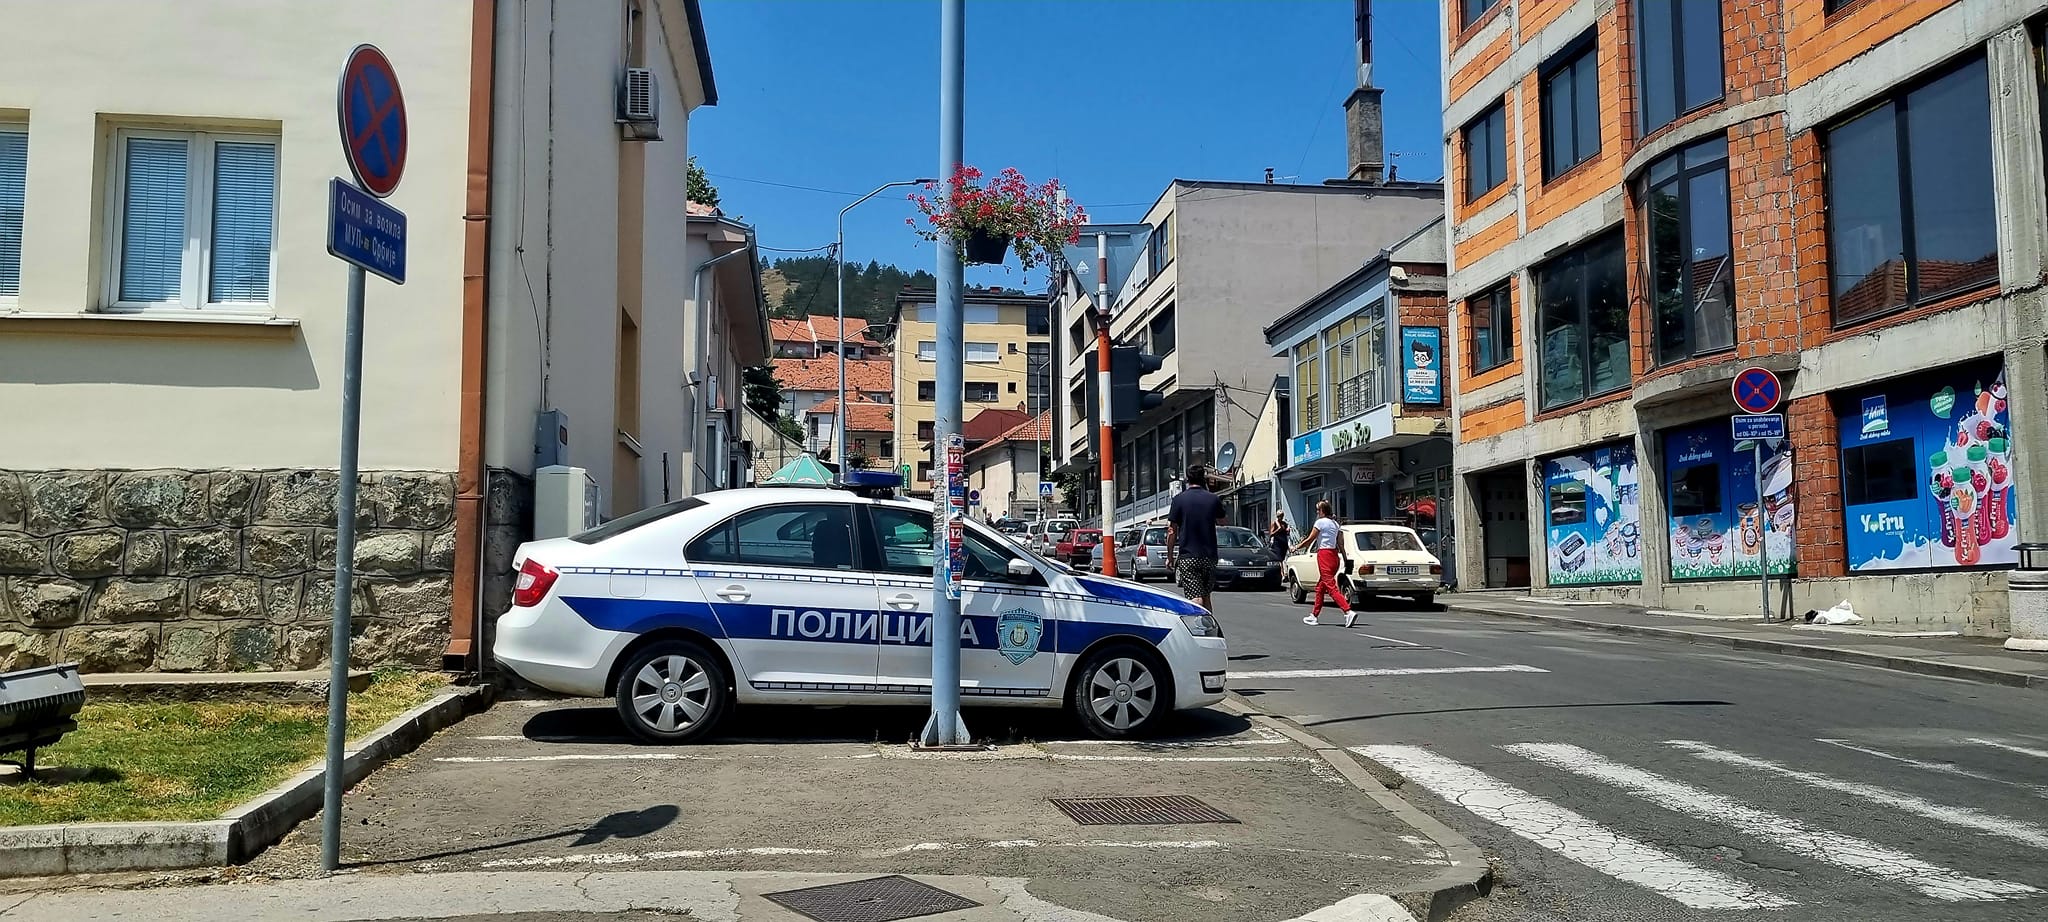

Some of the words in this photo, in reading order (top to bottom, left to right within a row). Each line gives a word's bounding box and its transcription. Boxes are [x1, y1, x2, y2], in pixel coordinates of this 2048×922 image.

[341, 191, 361, 219] Осим
[364, 208, 373, 225] за
[376, 215, 401, 240] возила
[372, 236, 396, 268] Србије
[770, 609, 980, 646] ПОЛИЦИА
